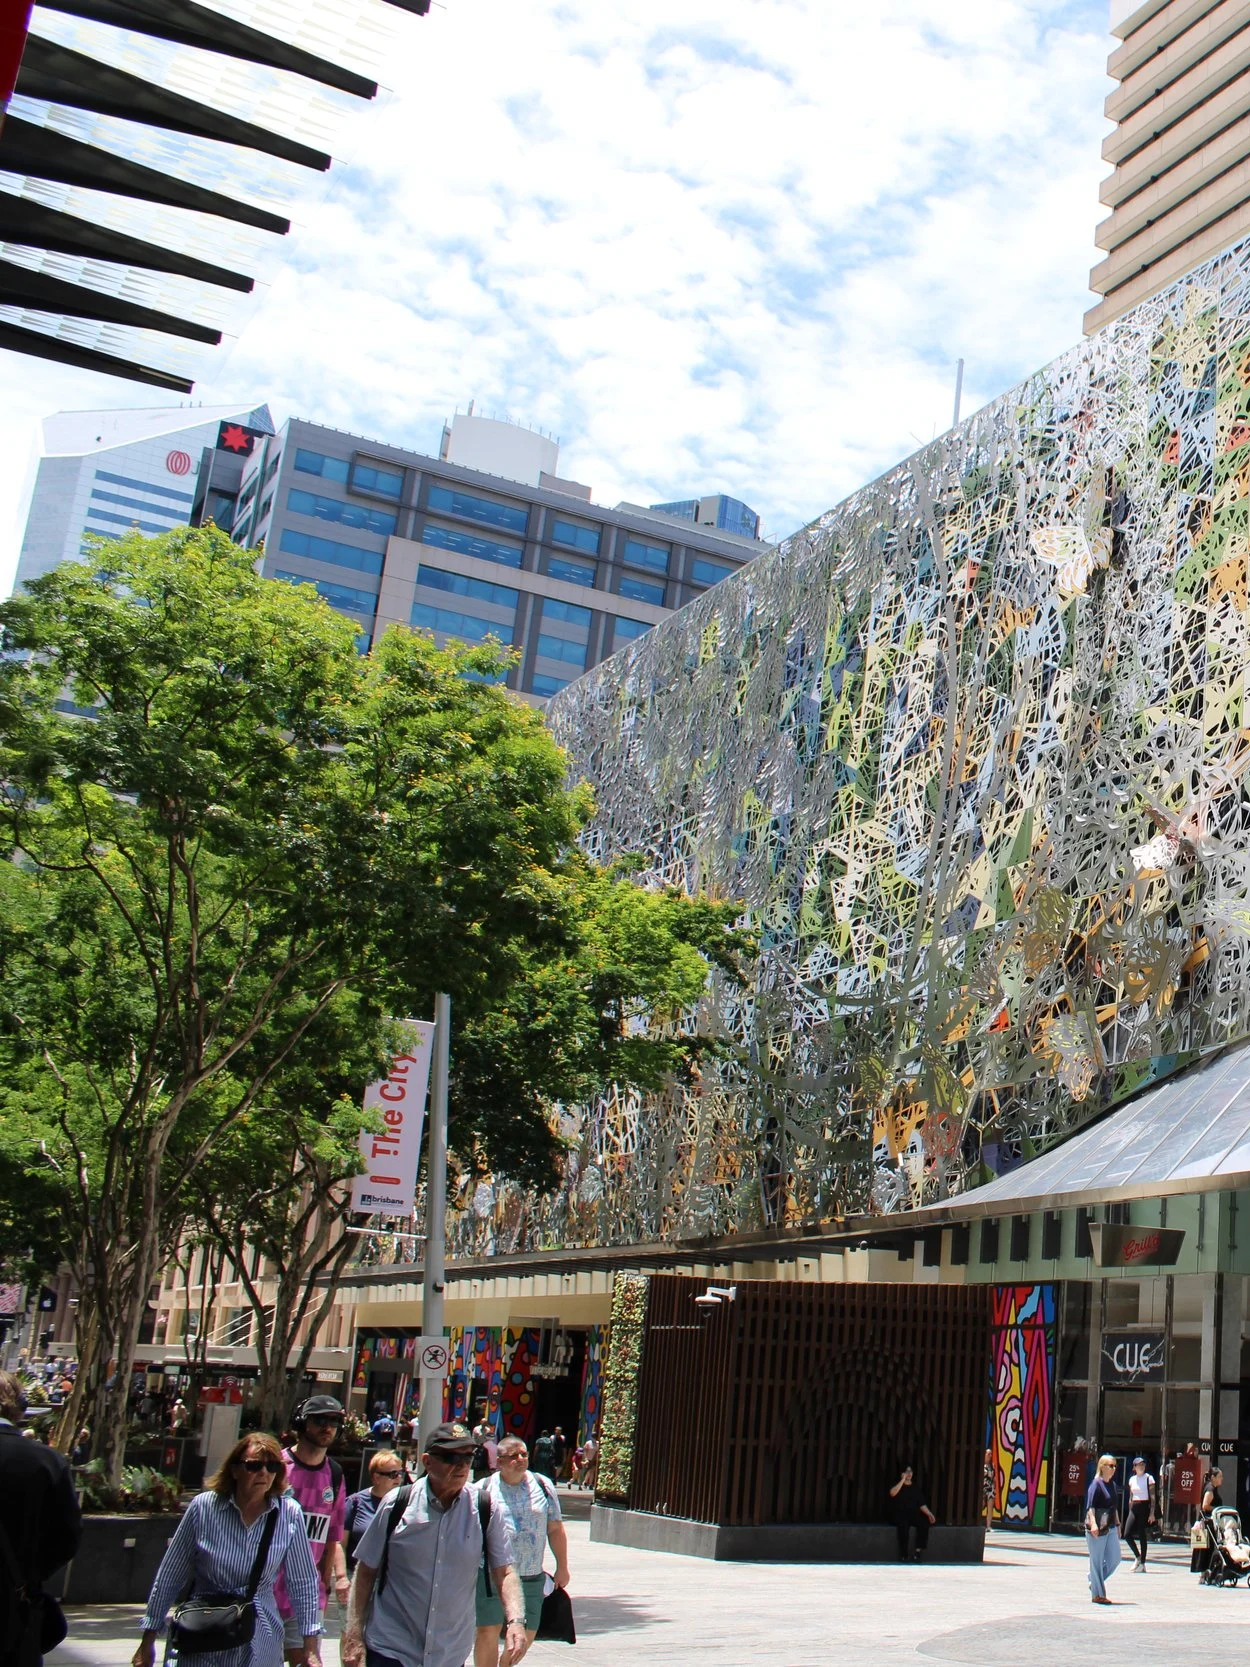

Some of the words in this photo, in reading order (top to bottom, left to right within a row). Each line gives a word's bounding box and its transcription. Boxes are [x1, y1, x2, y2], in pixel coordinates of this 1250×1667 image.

[371, 1109, 404, 1158] The
[372, 1195, 404, 1205] brisbane
[1113, 1343, 1151, 1373] CUE
[1219, 1442, 1234, 1452] CUE
[1068, 1472, 1080, 1480] OFF
[1180, 1479, 1194, 1487] OFF
